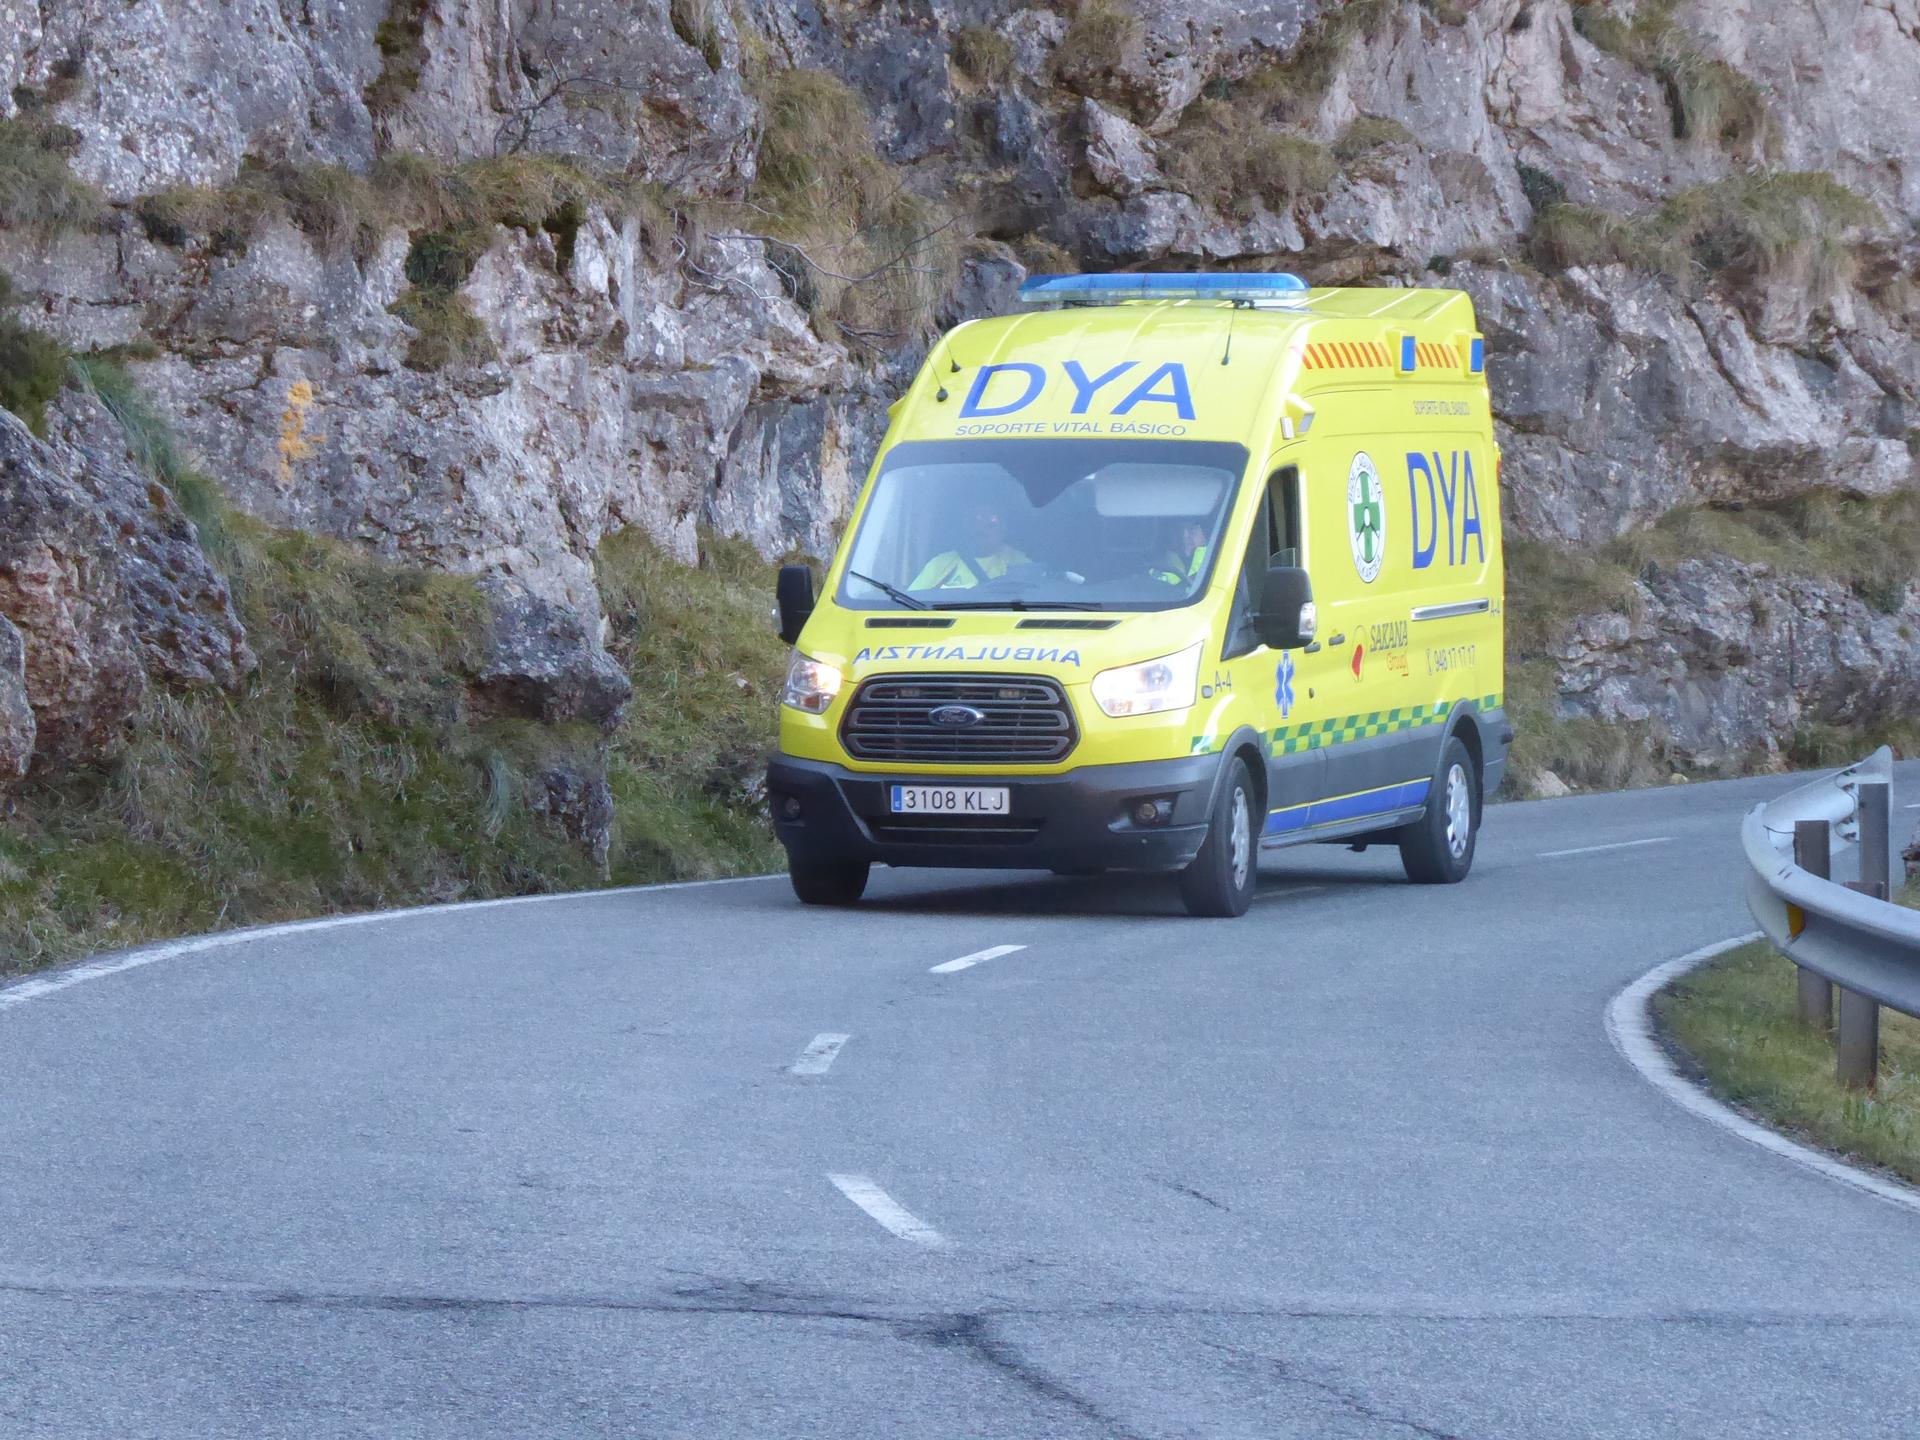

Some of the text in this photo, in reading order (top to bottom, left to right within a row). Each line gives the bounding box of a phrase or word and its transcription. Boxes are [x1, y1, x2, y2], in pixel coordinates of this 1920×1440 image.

[958, 360, 1196, 420] DYA
[955, 420, 1187, 436] SOPORTE VITAL BÁSICO
[1406, 450, 1485, 569] DYA
[1370, 620, 1408, 652] SAKANA
[1215, 671, 1232, 692] A-4
[906, 790, 1003, 811] 3108 KLJ
